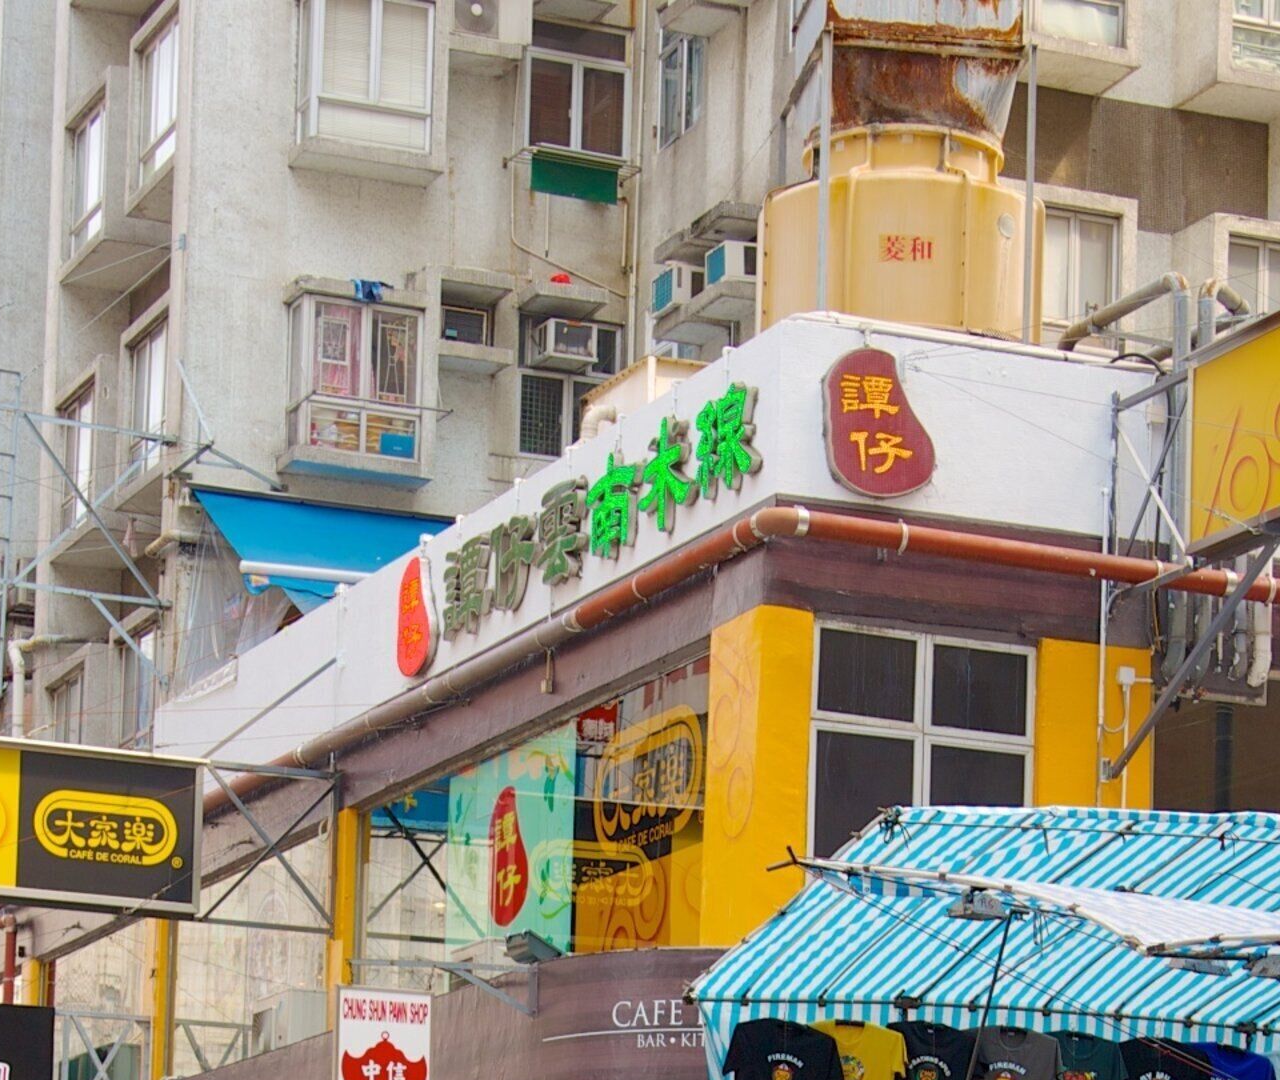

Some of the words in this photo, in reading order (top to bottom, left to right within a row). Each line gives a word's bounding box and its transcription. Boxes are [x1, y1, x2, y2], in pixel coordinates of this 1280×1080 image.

[839, 373, 912, 474] 譚仔
[96, 850, 110, 862] DE
[111, 852, 142, 865] CORAL
[343, 998, 366, 1020] CHUNG
[369, 1001, 387, 1021] SHUN
[389, 1001, 408, 1023] PAWN
[410, 1004, 428, 1024] SHOP
[612, 1001, 683, 1027] CAFE
[637, 1034, 666, 1048] BAR
